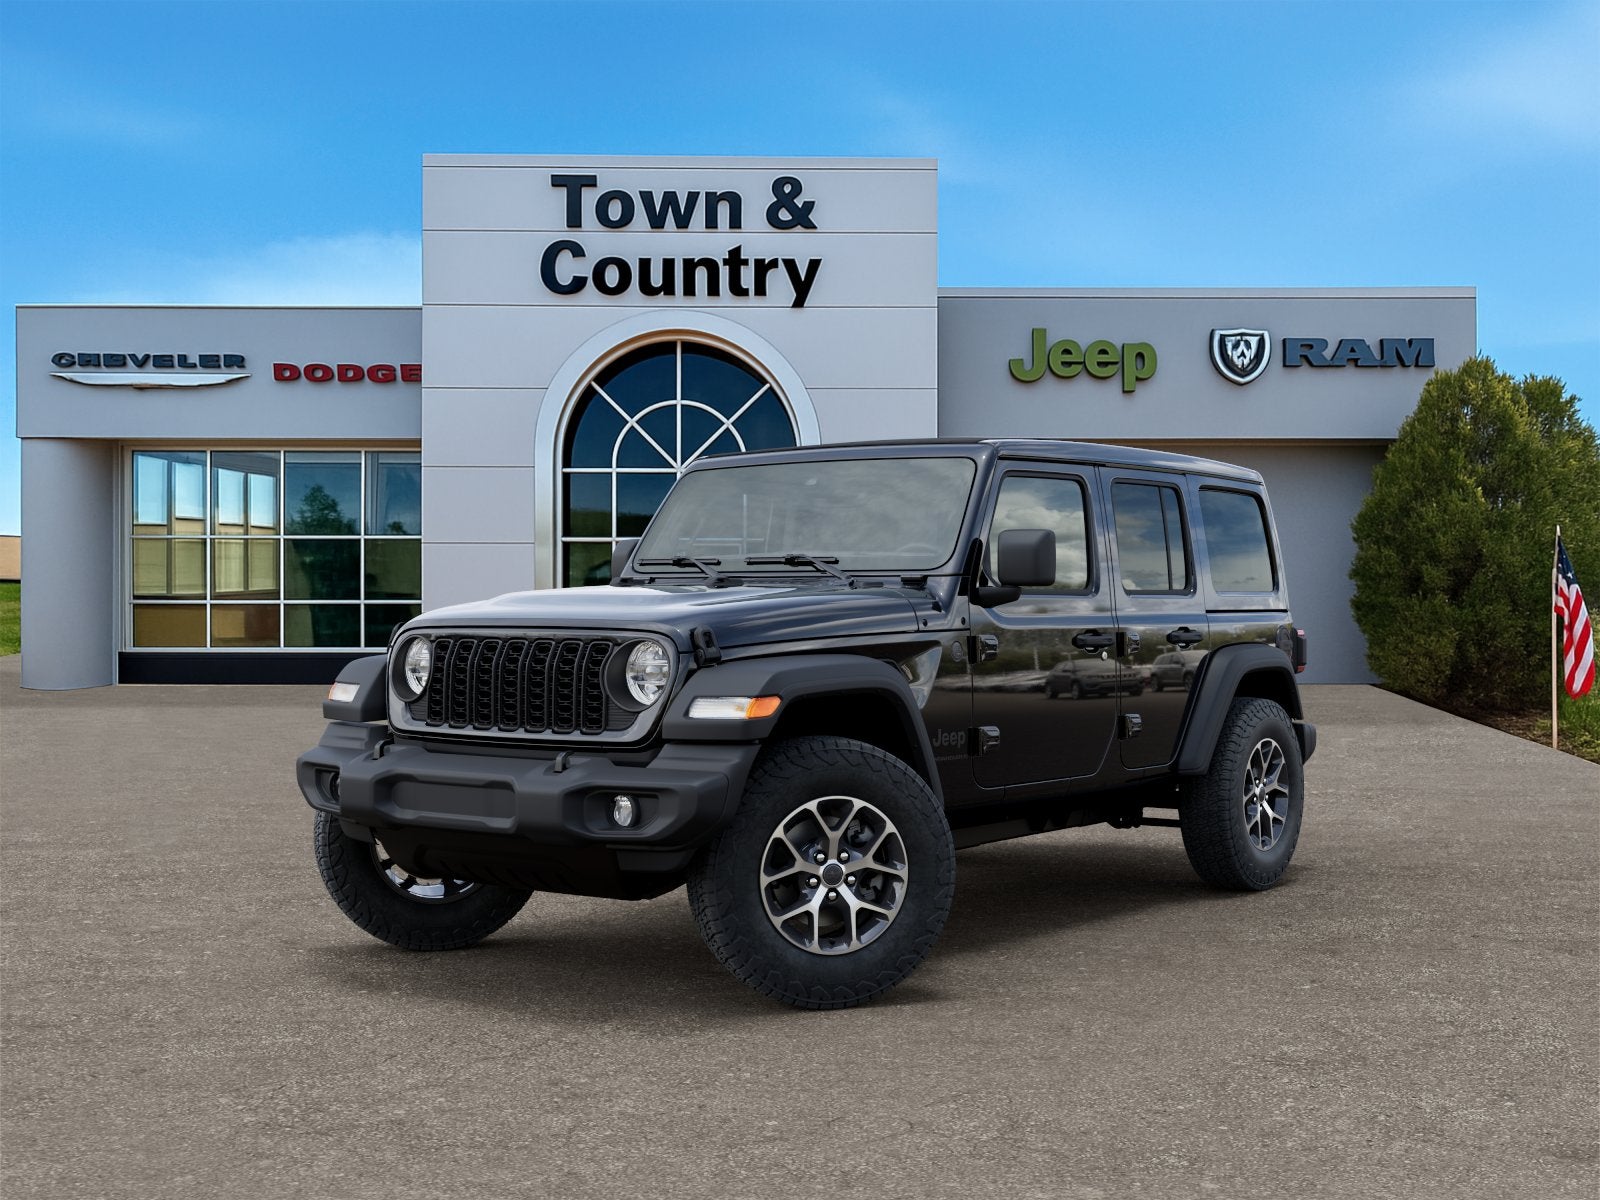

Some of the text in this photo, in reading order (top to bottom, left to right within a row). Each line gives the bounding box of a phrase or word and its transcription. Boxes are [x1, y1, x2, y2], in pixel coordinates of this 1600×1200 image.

[551, 174, 818, 230] Town &
[540, 239, 822, 308] Country
[272, 363, 422, 383] DODGE
[1009, 328, 1157, 392] Jeep
[1282, 338, 1435, 368] RAM
[932, 729, 966, 748] Jeep
